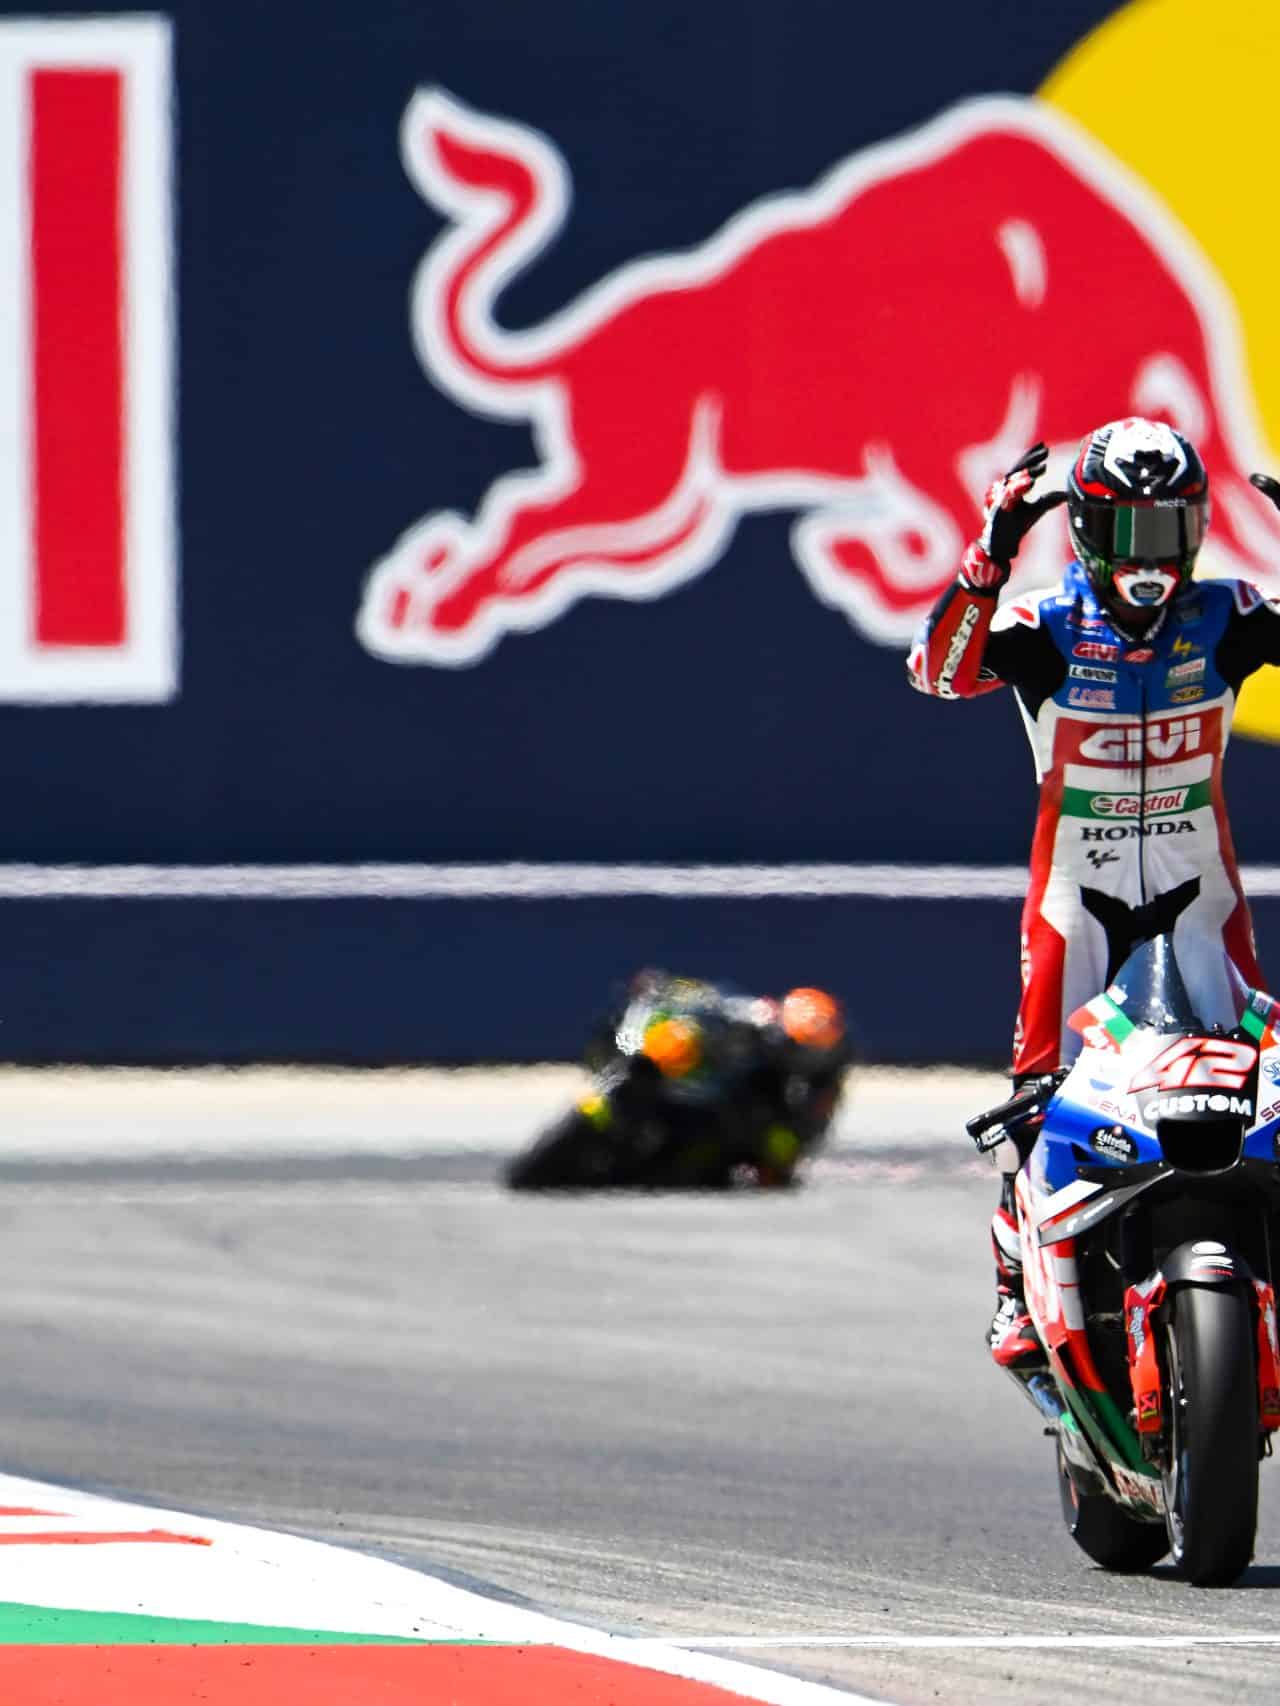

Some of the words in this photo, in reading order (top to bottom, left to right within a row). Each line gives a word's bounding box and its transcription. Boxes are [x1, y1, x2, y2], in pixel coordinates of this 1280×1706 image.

[1079, 717, 1201, 760] GIVI
[1114, 791, 1183, 815] Castrol
[1080, 820, 1197, 841] HONDA
[1127, 1037, 1258, 1094] 42
[1143, 1094, 1251, 1121] CUSTOM
